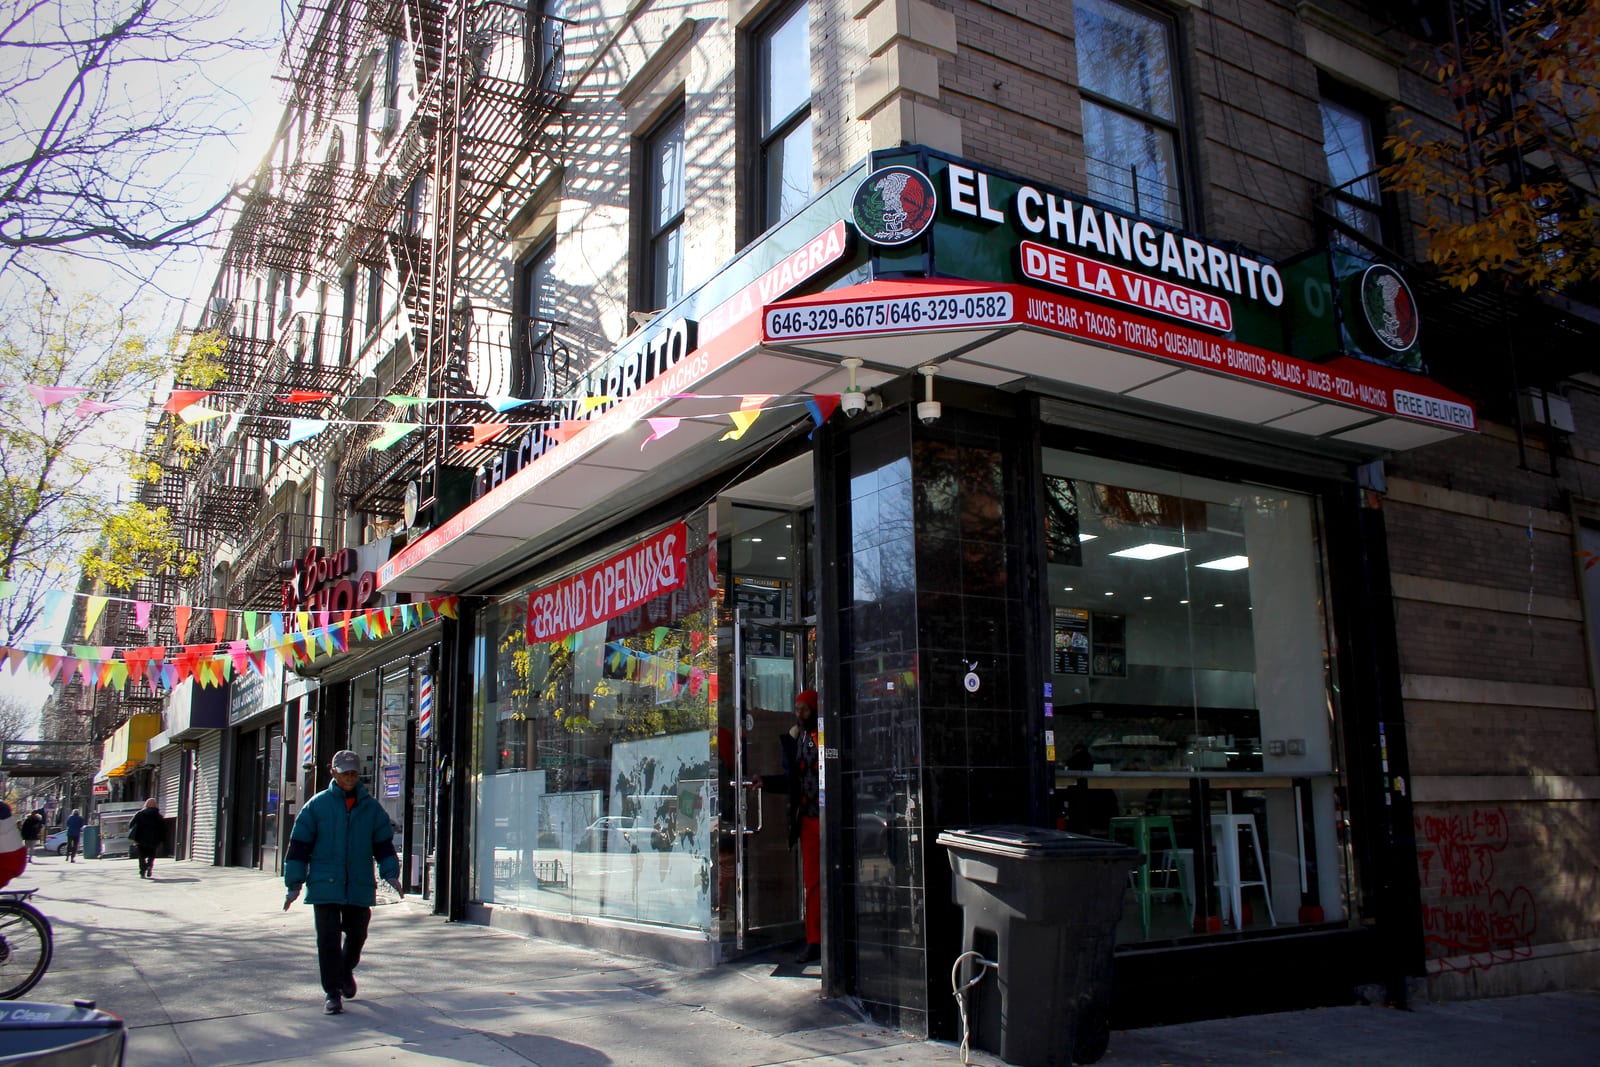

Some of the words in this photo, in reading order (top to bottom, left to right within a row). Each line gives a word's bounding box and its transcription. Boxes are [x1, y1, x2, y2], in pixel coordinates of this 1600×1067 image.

[948, 163, 1005, 224] EL
[1017, 186, 1284, 307] CHANGARRITO
[701, 307, 725, 344] DE
[729, 291, 753, 321] LA
[758, 228, 841, 300] VIAGRA
[772, 296, 1007, 335] 646-329-6675/646-329-0582
[1026, 247, 1068, 284] DE
[1077, 261, 1116, 297] LA
[1122, 274, 1227, 328] VIAGRA
[660, 351, 709, 396] NACHOS
[1027, 297, 1054, 323] JUICE
[1057, 305, 1078, 329] BAR
[1085, 311, 1117, 338] TACOS
[1122, 320, 1158, 348] TORTAS
[1164, 331, 1222, 364] QUESADILLAS
[1227, 347, 1266, 375] BURRITOS
[1272, 359, 1301, 384] SALADS
[1306, 368, 1331, 392] JUICES
[1335, 376, 1356, 399] PIZZA
[1360, 383, 1387, 408] NACHOS
[1396, 393, 1424, 415] FREE
[1425, 400, 1472, 427] DELIVERY
[304, 546, 351, 597] Born
[531, 577, 587, 640] GRAND
[591, 533, 681, 621] OPENING
[10, 1007, 51, 1022] Clean
